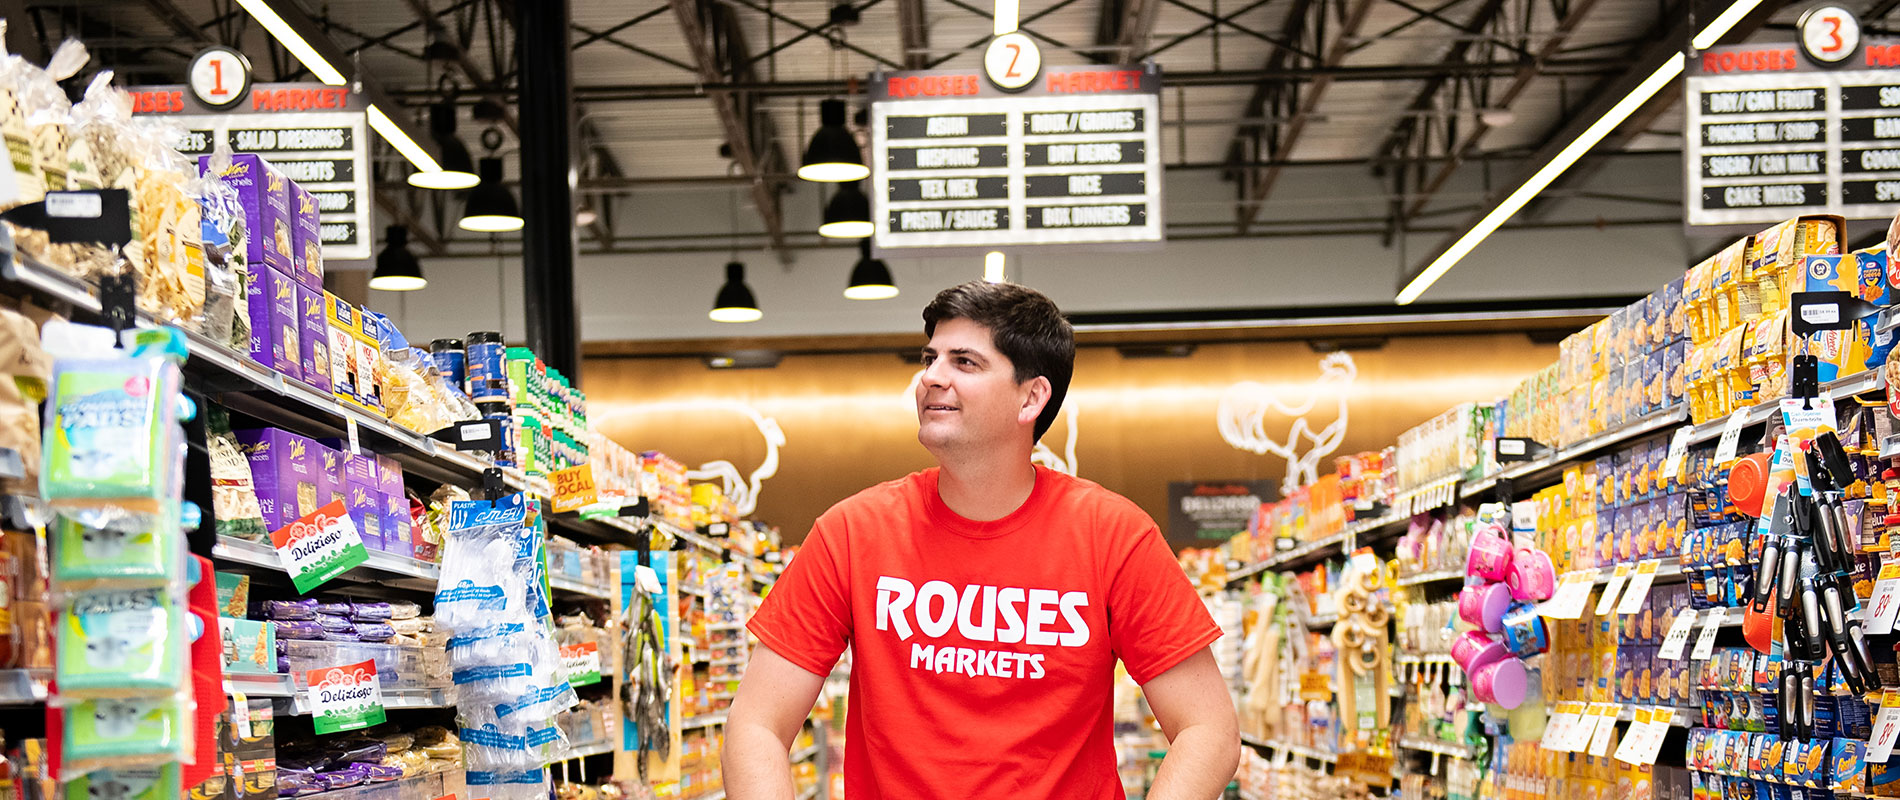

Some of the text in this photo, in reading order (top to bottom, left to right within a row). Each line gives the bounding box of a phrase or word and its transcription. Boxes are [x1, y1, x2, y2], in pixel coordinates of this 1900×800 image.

[1821, 17, 1843, 53] 3
[1005, 43, 1021, 78] 2
[1703, 49, 1797, 74] ROUSES
[209, 60, 228, 96] 1
[888, 70, 1142, 98] ROUSES MARKET
[252, 88, 350, 111] MARKET
[237, 129, 345, 150] SALAD DRESSINGS
[557, 469, 581, 484] BUY
[453, 502, 476, 510] PLASTIC
[475, 506, 523, 523] CUTLERY
[291, 529, 343, 562] Delizioso
[876, 575, 1090, 647] ROUSES
[910, 643, 1046, 679] MARKETS
[320, 686, 374, 704] Delizioso
